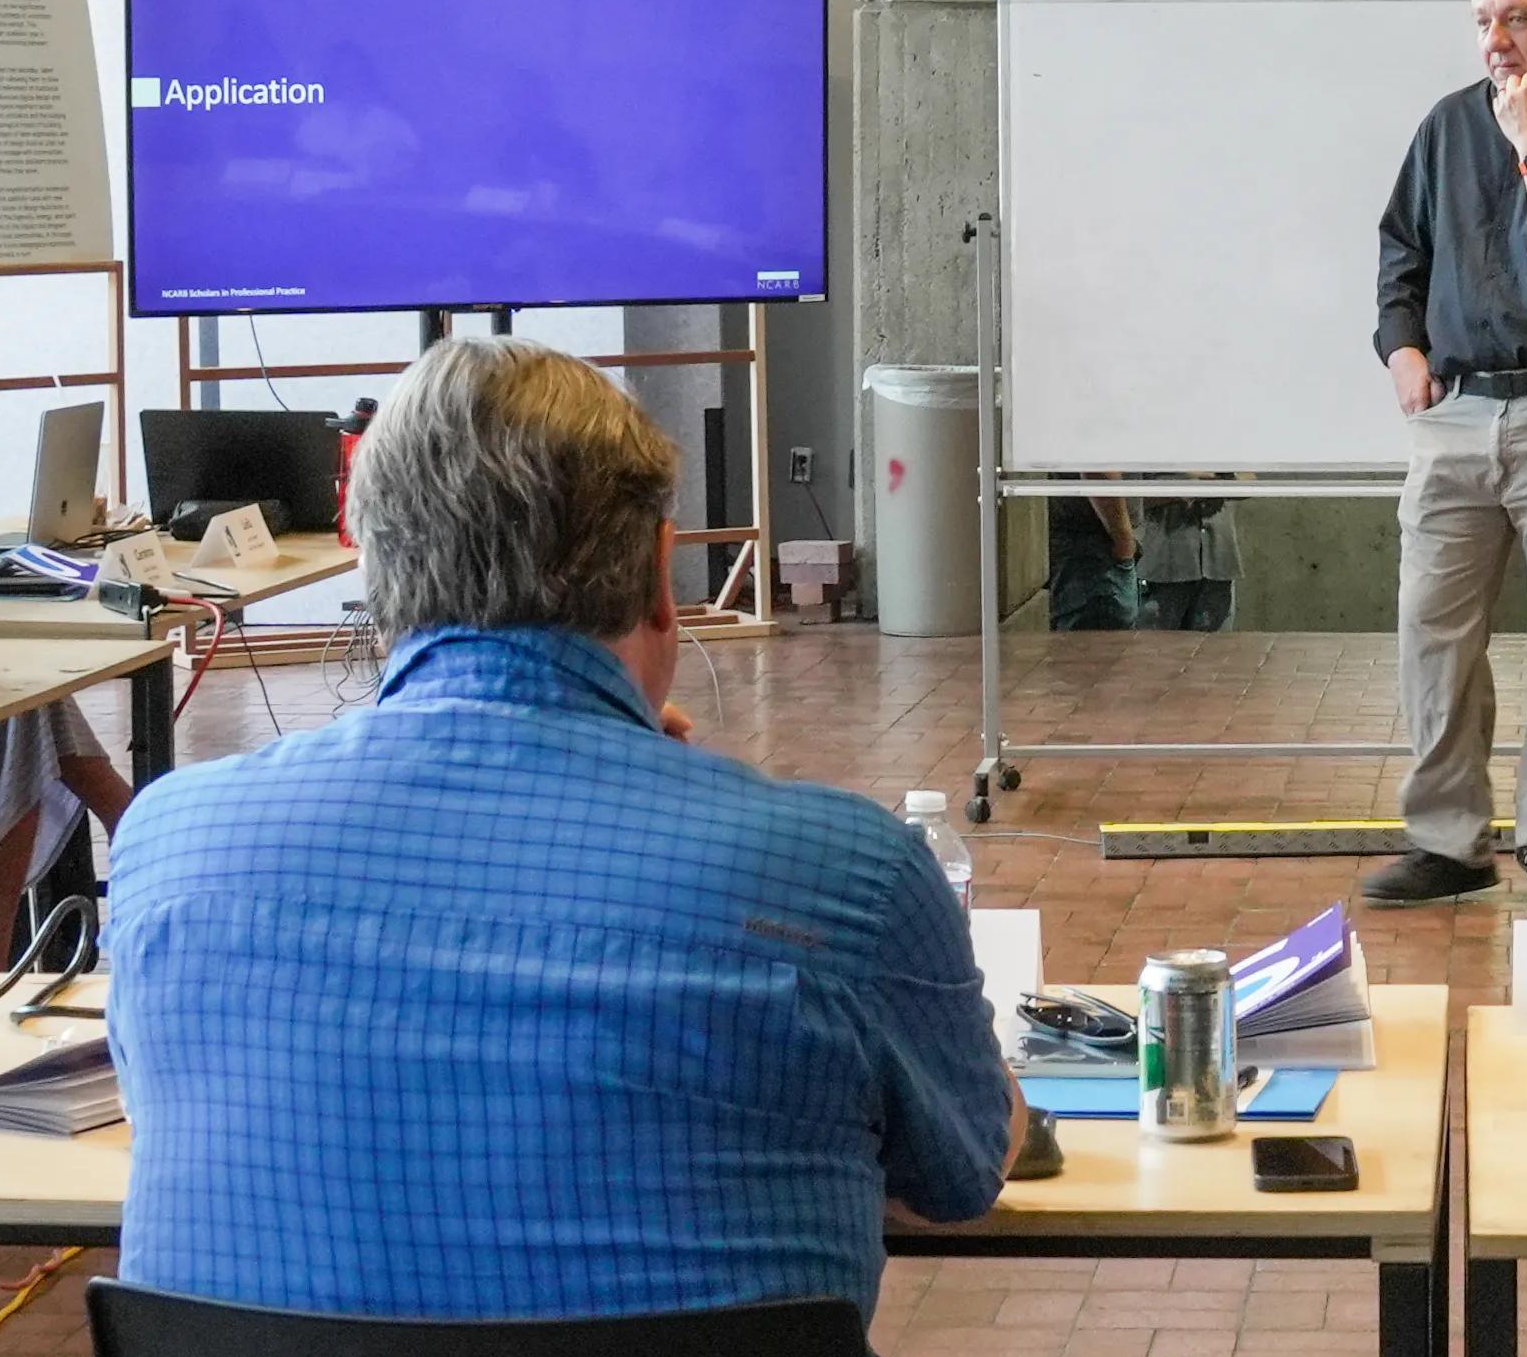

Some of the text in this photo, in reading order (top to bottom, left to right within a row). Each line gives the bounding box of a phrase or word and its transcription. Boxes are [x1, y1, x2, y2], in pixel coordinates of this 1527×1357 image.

[165, 77, 324, 111] Application
[757, 280, 800, 290] NCARB
[162, 289, 188, 298] NCARB
[189, 288, 220, 298] Scholars
[230, 287, 275, 297] Professional
[276, 286, 306, 296] Practice
